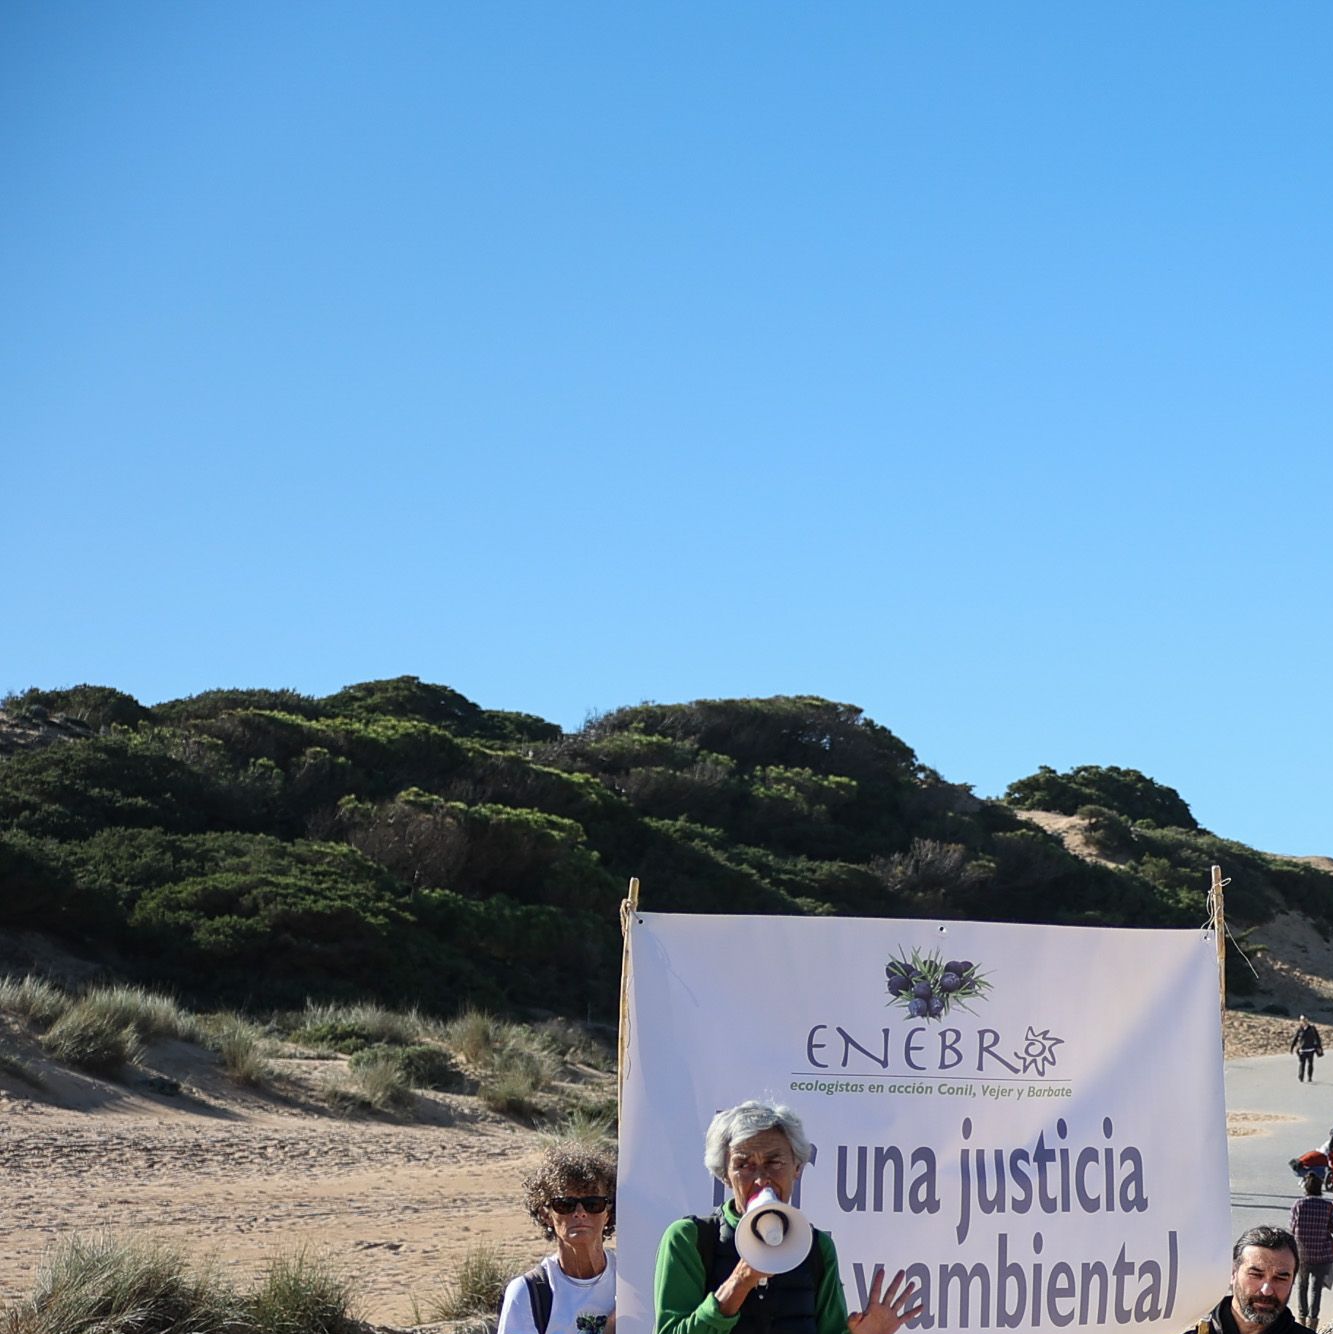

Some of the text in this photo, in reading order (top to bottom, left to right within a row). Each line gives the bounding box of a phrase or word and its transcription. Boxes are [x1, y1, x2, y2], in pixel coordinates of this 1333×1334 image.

[790, 1079, 1072, 1101] ecologistas en acción Conil, Vejer y Barbate
[836, 1144, 940, 1213] una
[956, 1116, 1148, 1245] justicia
[905, 1231, 1178, 1329] ambiental
